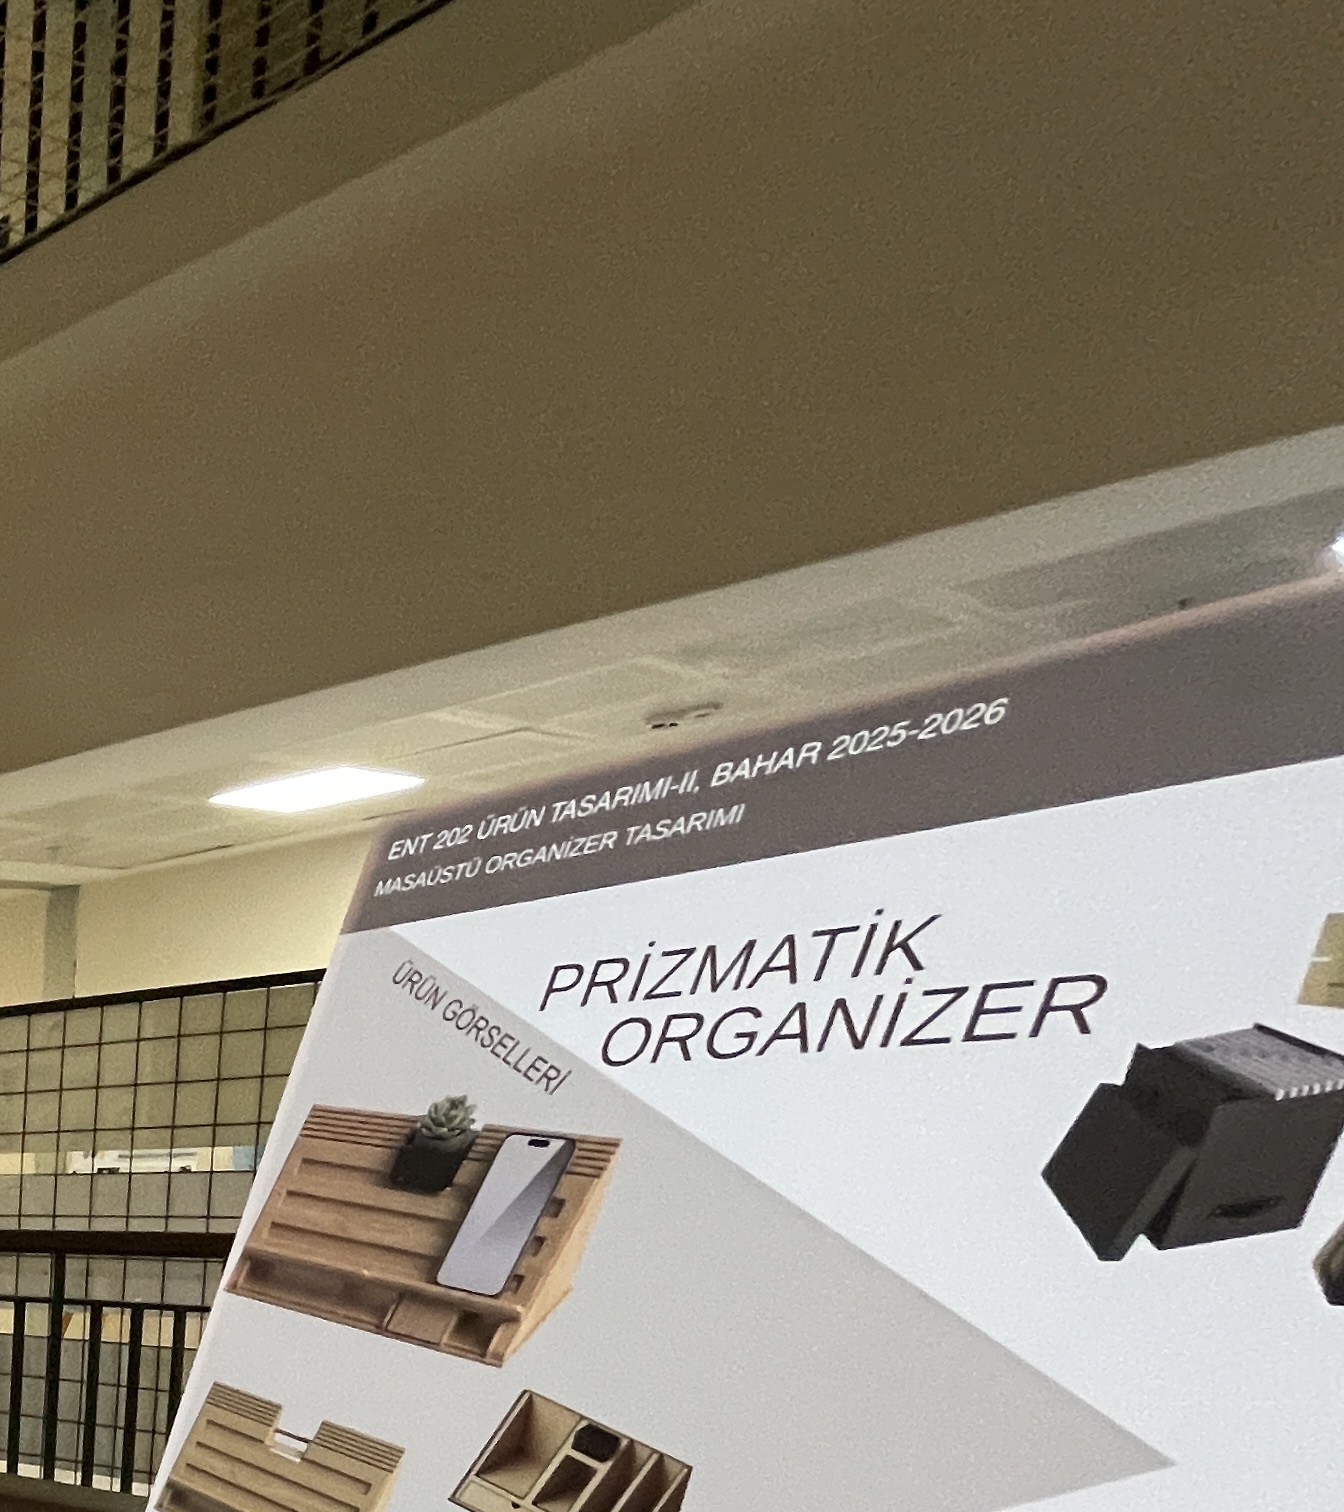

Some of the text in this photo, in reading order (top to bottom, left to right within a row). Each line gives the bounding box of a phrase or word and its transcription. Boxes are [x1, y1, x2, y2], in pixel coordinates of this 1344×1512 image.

[388, 833, 431, 861] ENT
[433, 825, 472, 851] 202
[477, 806, 546, 840] ÜRÜN
[710, 741, 822, 787] BAHAR
[827, 697, 1008, 760] 2025-2026
[373, 803, 746, 897] MASAÜSTÜ ORGANİZER TASARIMI
[539, 909, 942, 1011] PRİZMATİK
[392, 960, 572, 1096] ÜRÜN GÖRSELLERİ
[601, 974, 1108, 1069] ORGANİZER
